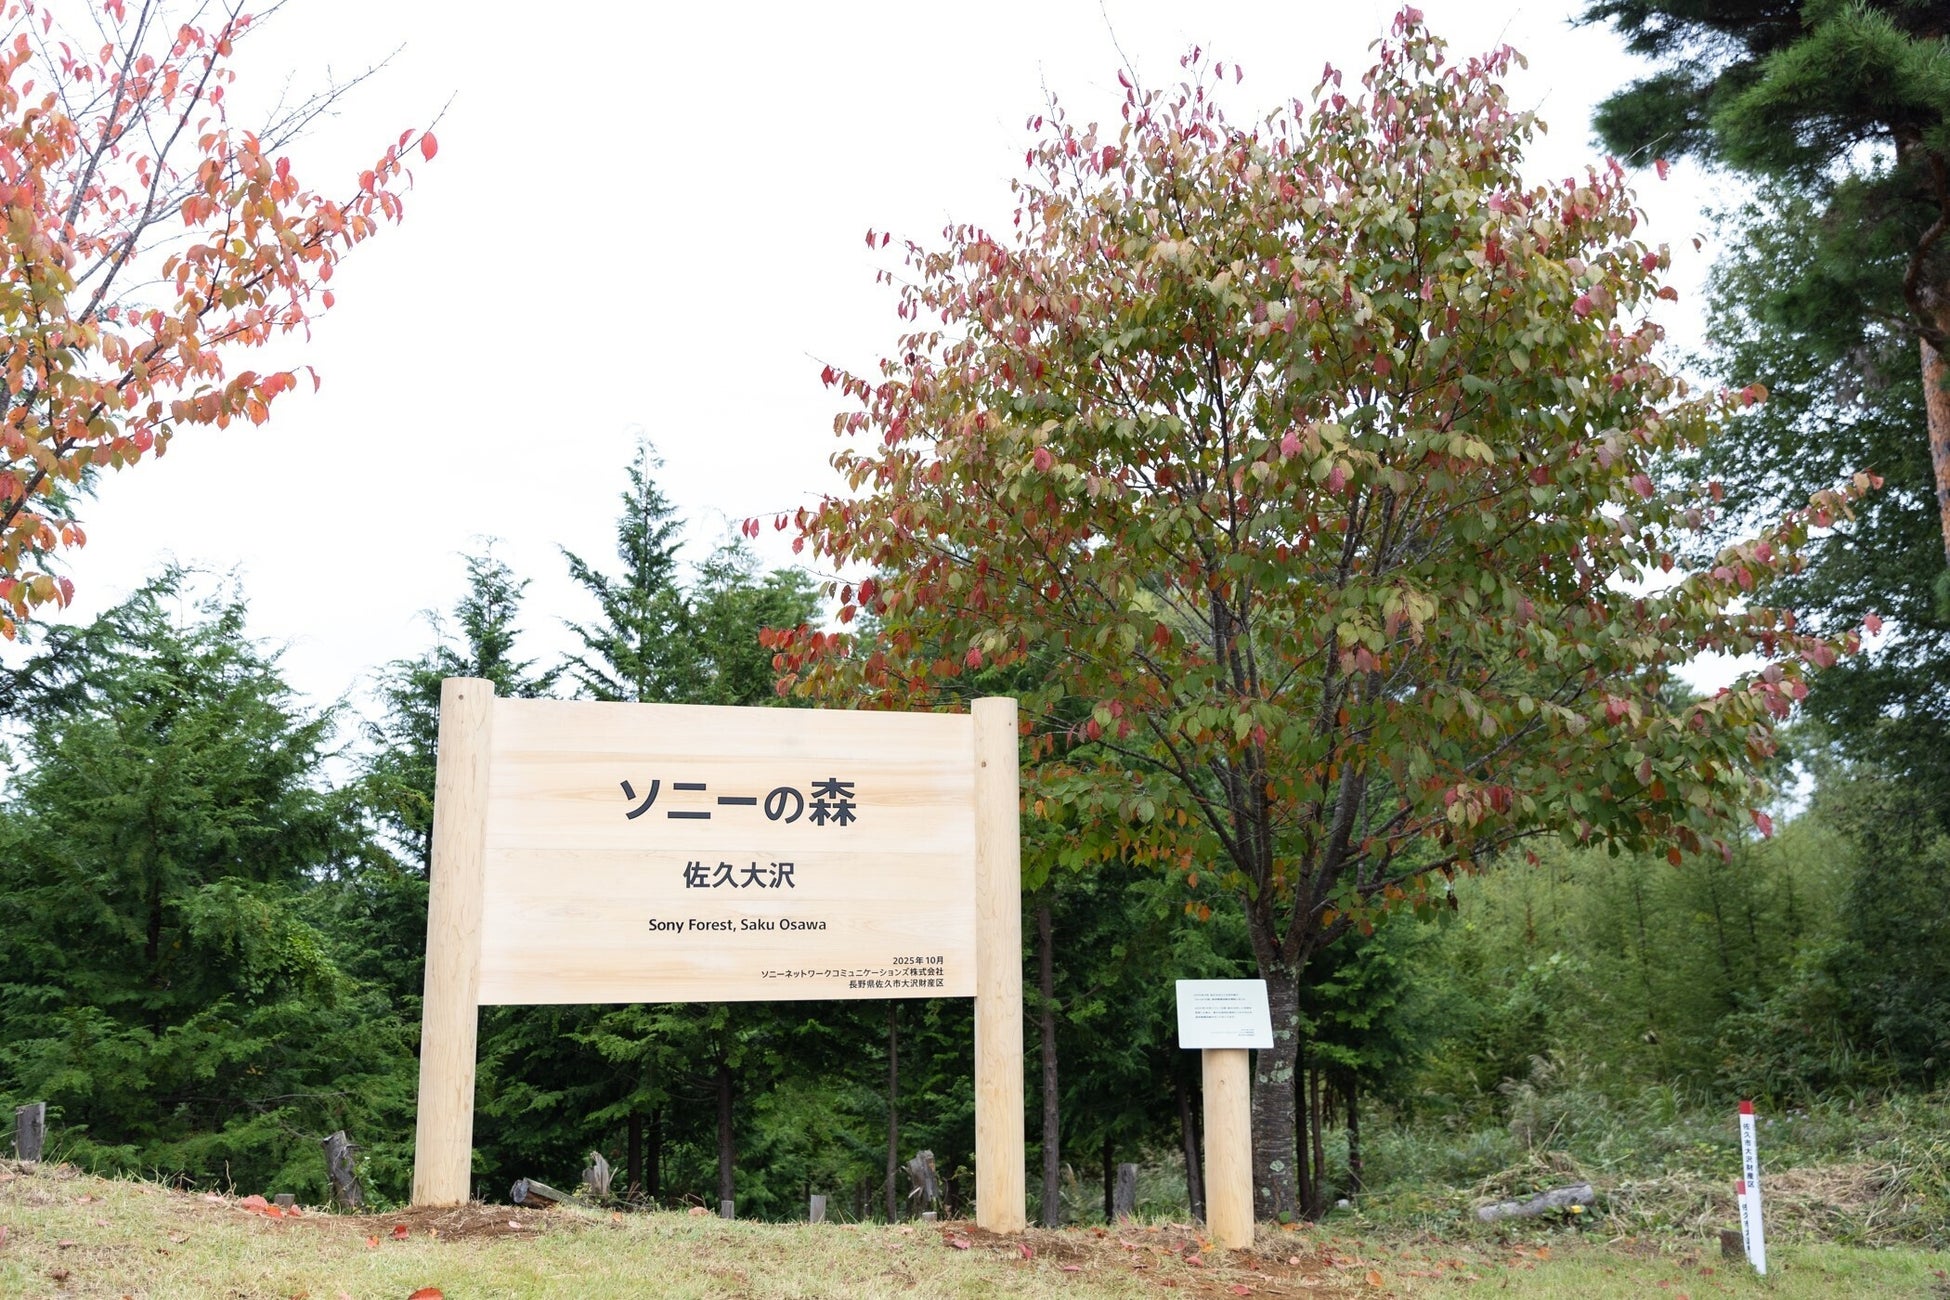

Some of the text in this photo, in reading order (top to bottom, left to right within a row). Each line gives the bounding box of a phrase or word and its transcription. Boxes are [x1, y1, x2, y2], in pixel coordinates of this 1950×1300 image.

[620, 777, 857, 827] ソニーの森
[683, 861, 796, 889] 佐久大沢
[648, 918, 827, 933] Sony Forest, Saku Osawa
[761, 967, 944, 979] ソニーネットワークコミュニケーションズ株式会社
[849, 978, 944, 989] 長野県佐久市大沢財産区
